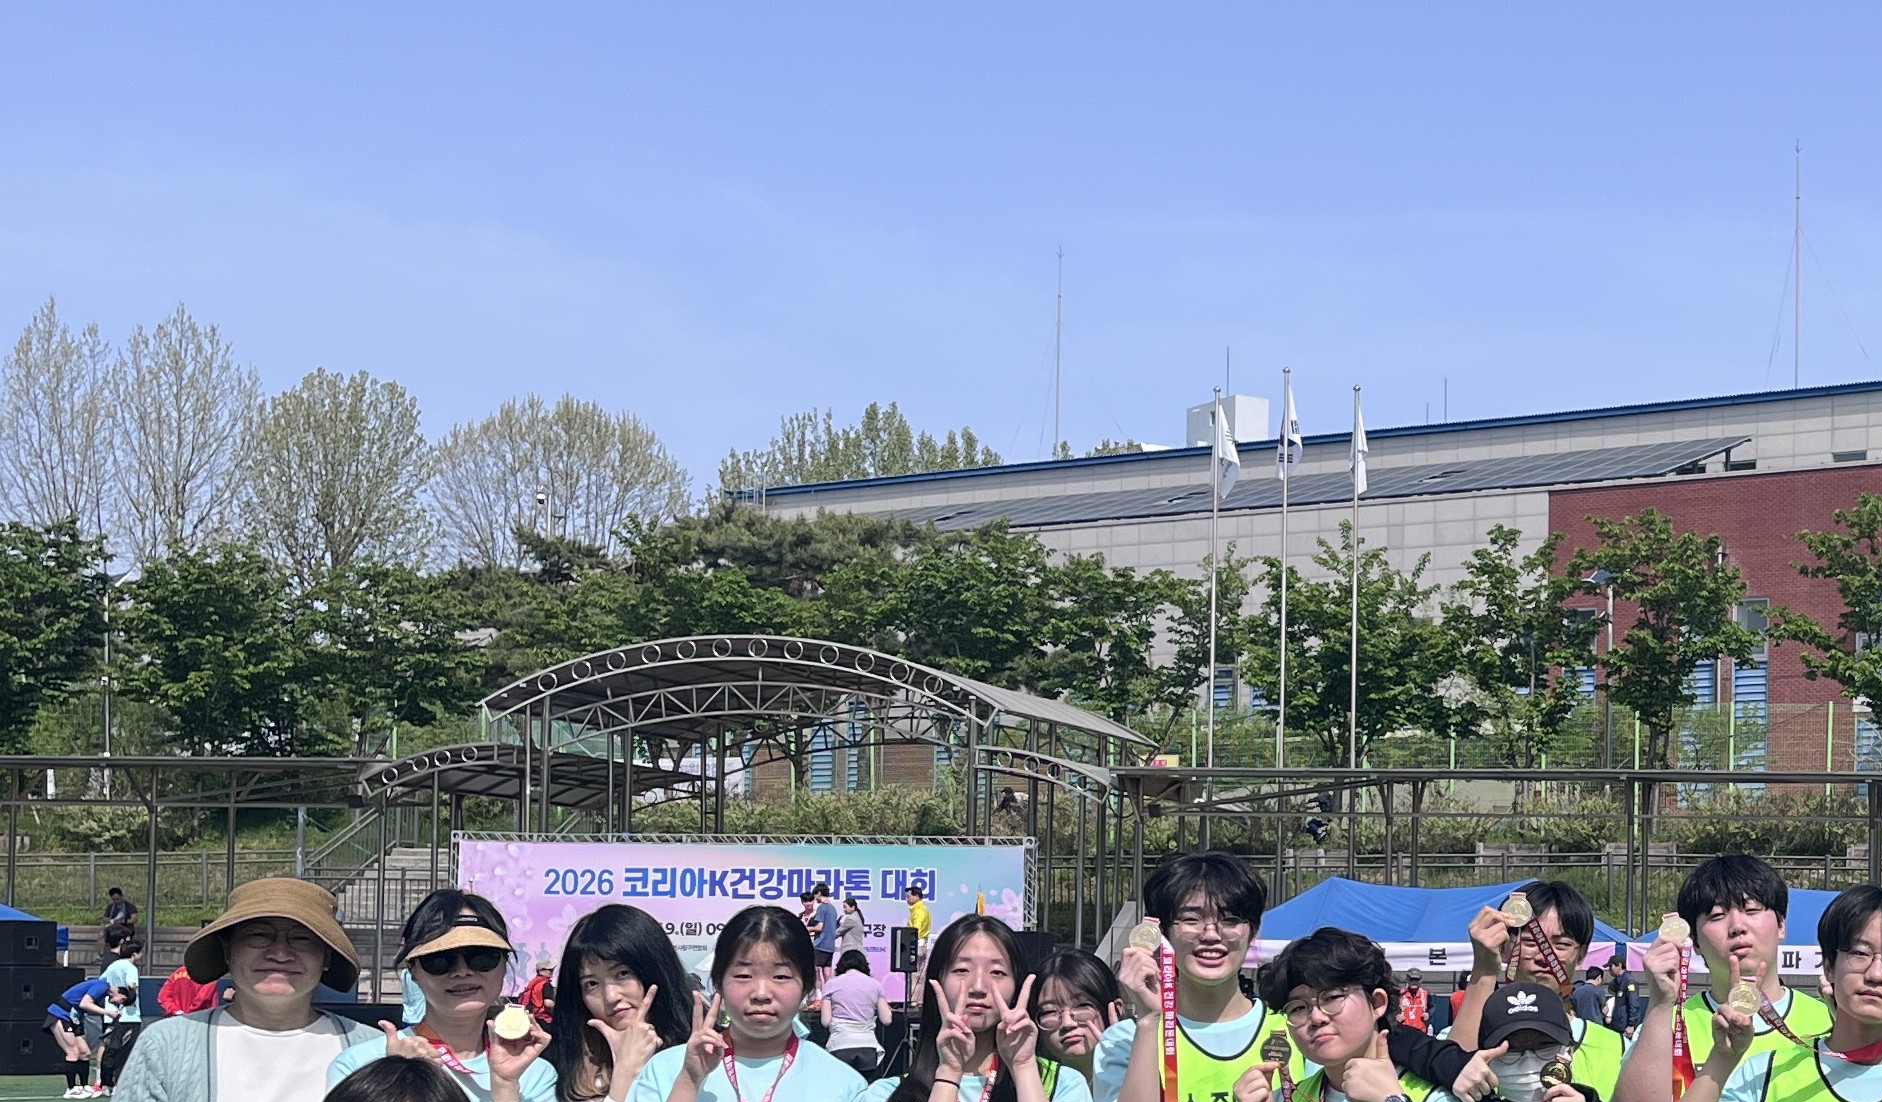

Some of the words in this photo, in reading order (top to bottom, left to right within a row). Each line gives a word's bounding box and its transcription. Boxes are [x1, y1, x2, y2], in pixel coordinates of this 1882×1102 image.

[544, 868, 614, 896] 2026
[881, 868, 936, 901] 대회
[1507, 1004, 1539, 1015] adidas
